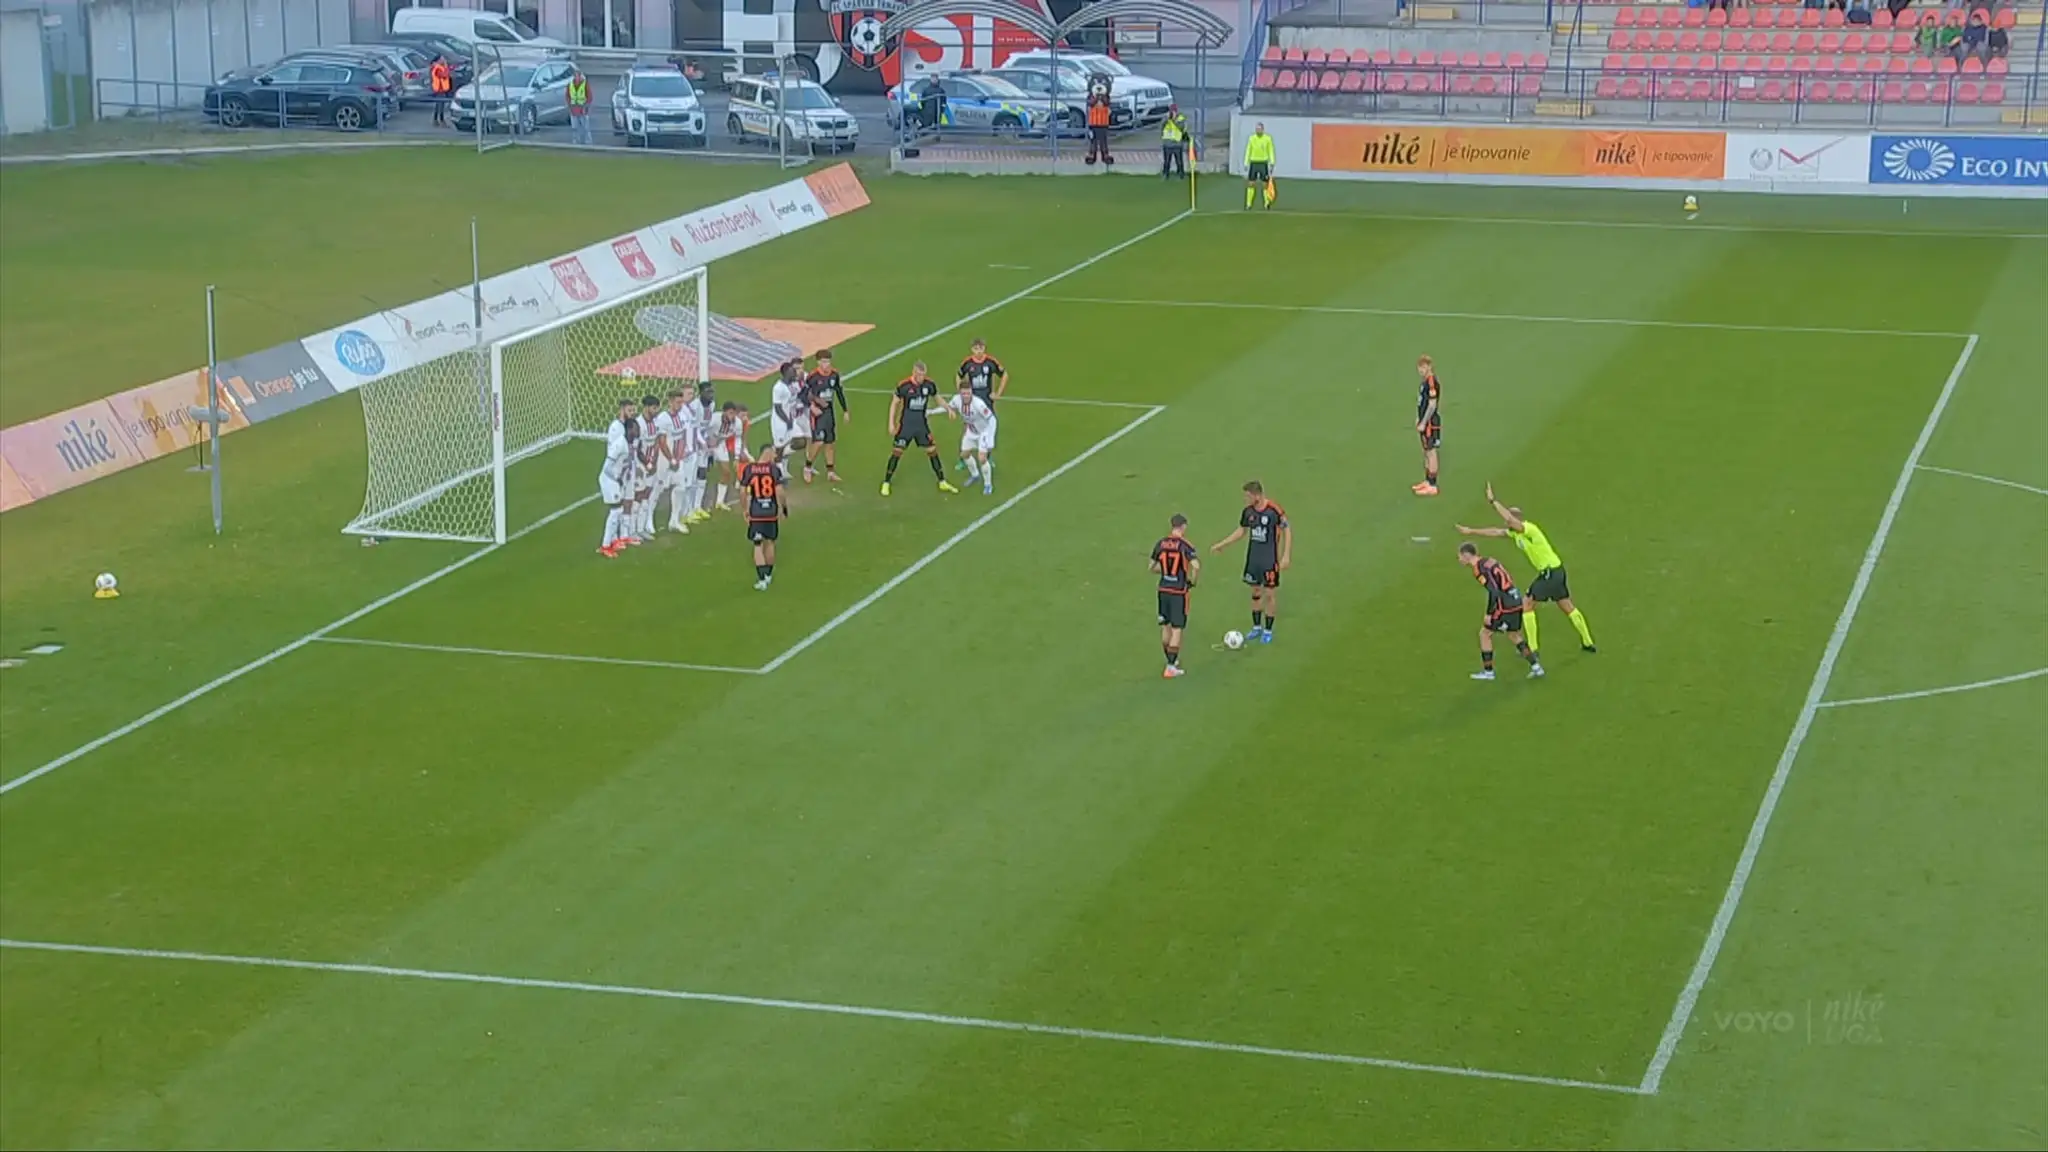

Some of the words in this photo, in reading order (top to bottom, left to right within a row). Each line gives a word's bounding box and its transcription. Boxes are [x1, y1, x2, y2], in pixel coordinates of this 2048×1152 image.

[1362, 132, 1420, 165] niké
[1442, 144, 1461, 163] je
[1461, 144, 1531, 164] tipovanie
[1596, 141, 1636, 165] niké
[1664, 150, 1714, 164] tipovanie
[1961, 157, 2007, 178] ECO
[57, 418, 117, 472] niké
[138, 402, 193, 439] tipovani
[751, 475, 773, 498] 18
[1159, 551, 1181, 576] 17
